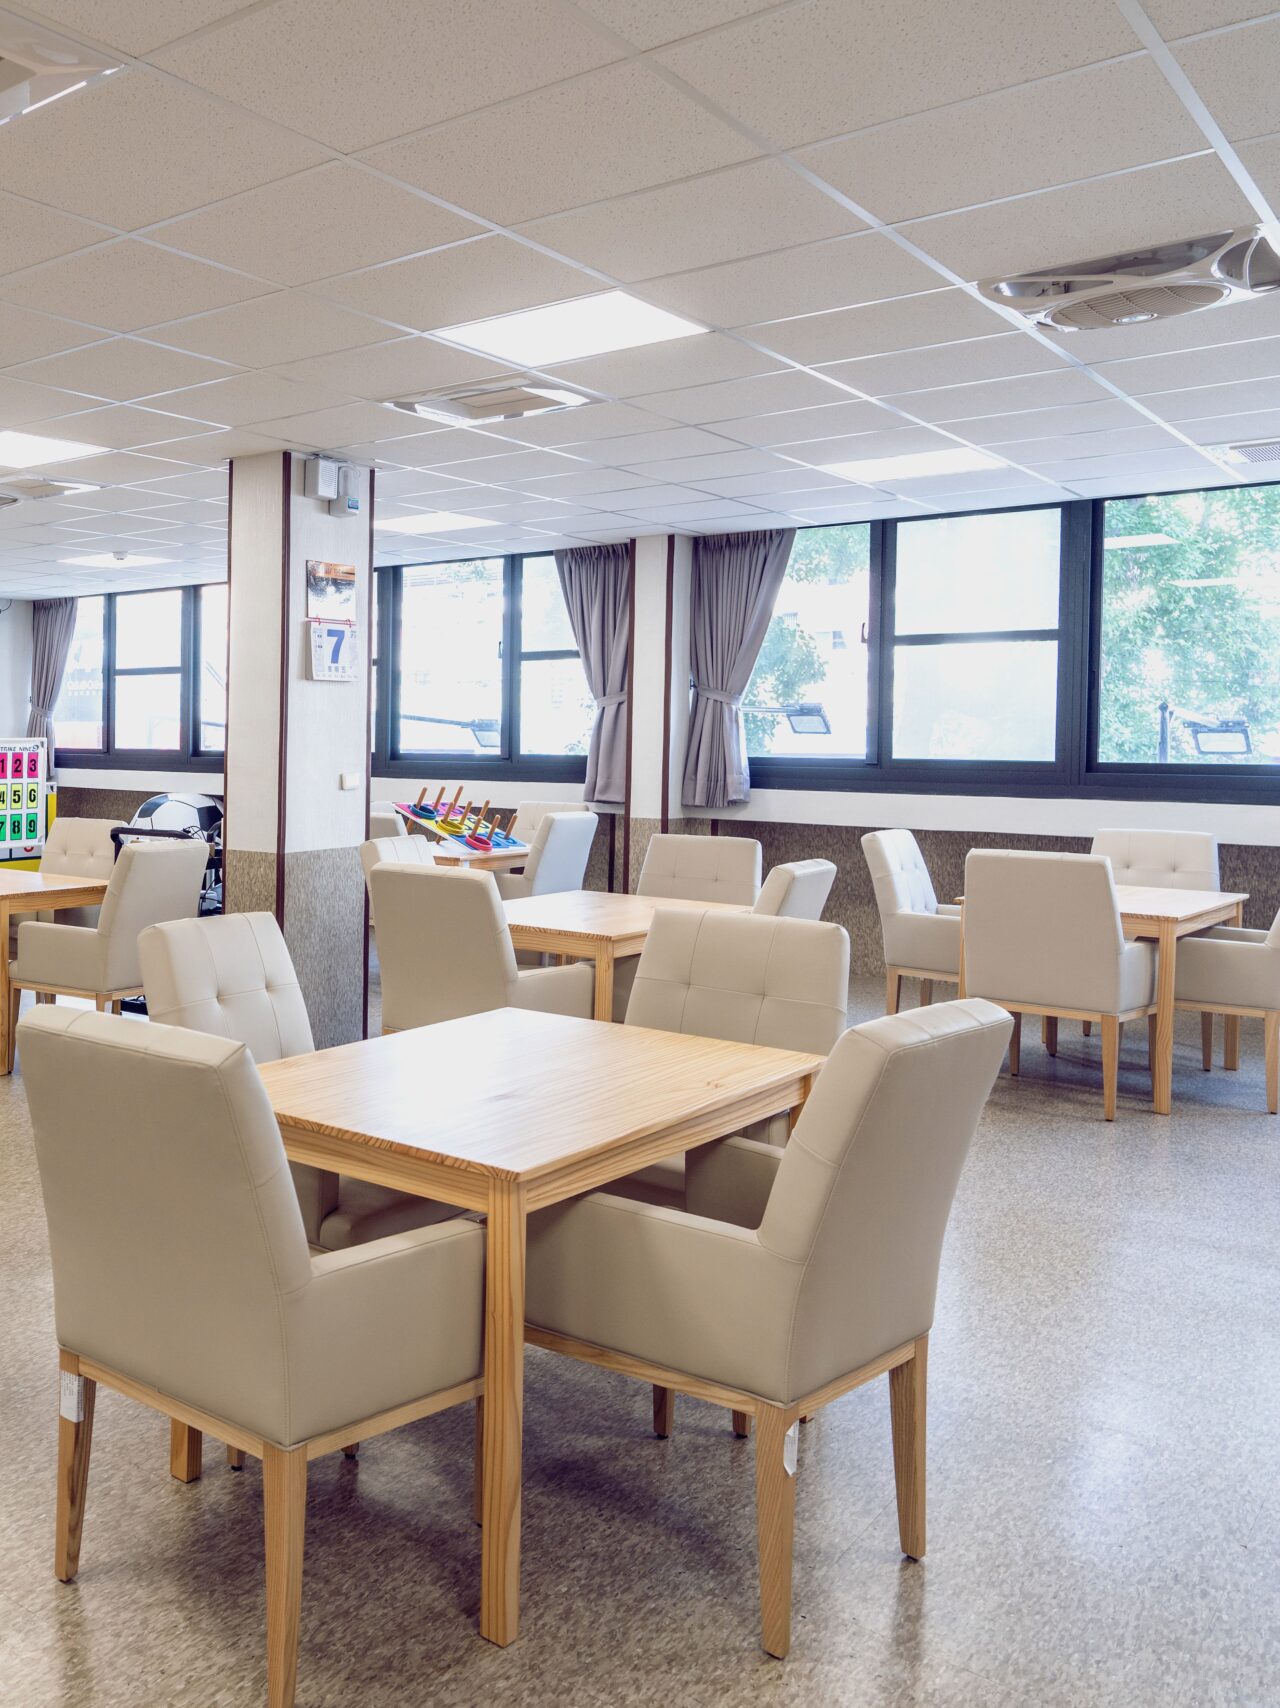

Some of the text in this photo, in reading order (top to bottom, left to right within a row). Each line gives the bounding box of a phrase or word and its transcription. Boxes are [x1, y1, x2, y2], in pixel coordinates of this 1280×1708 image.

[326, 629, 345, 664] 7
[0, 758, 37, 774] 1 2 3
[12, 789, 21, 803] 5
[28, 788, 36, 802] 6
[12, 820, 20, 834] 8
[28, 819, 36, 833] 9
